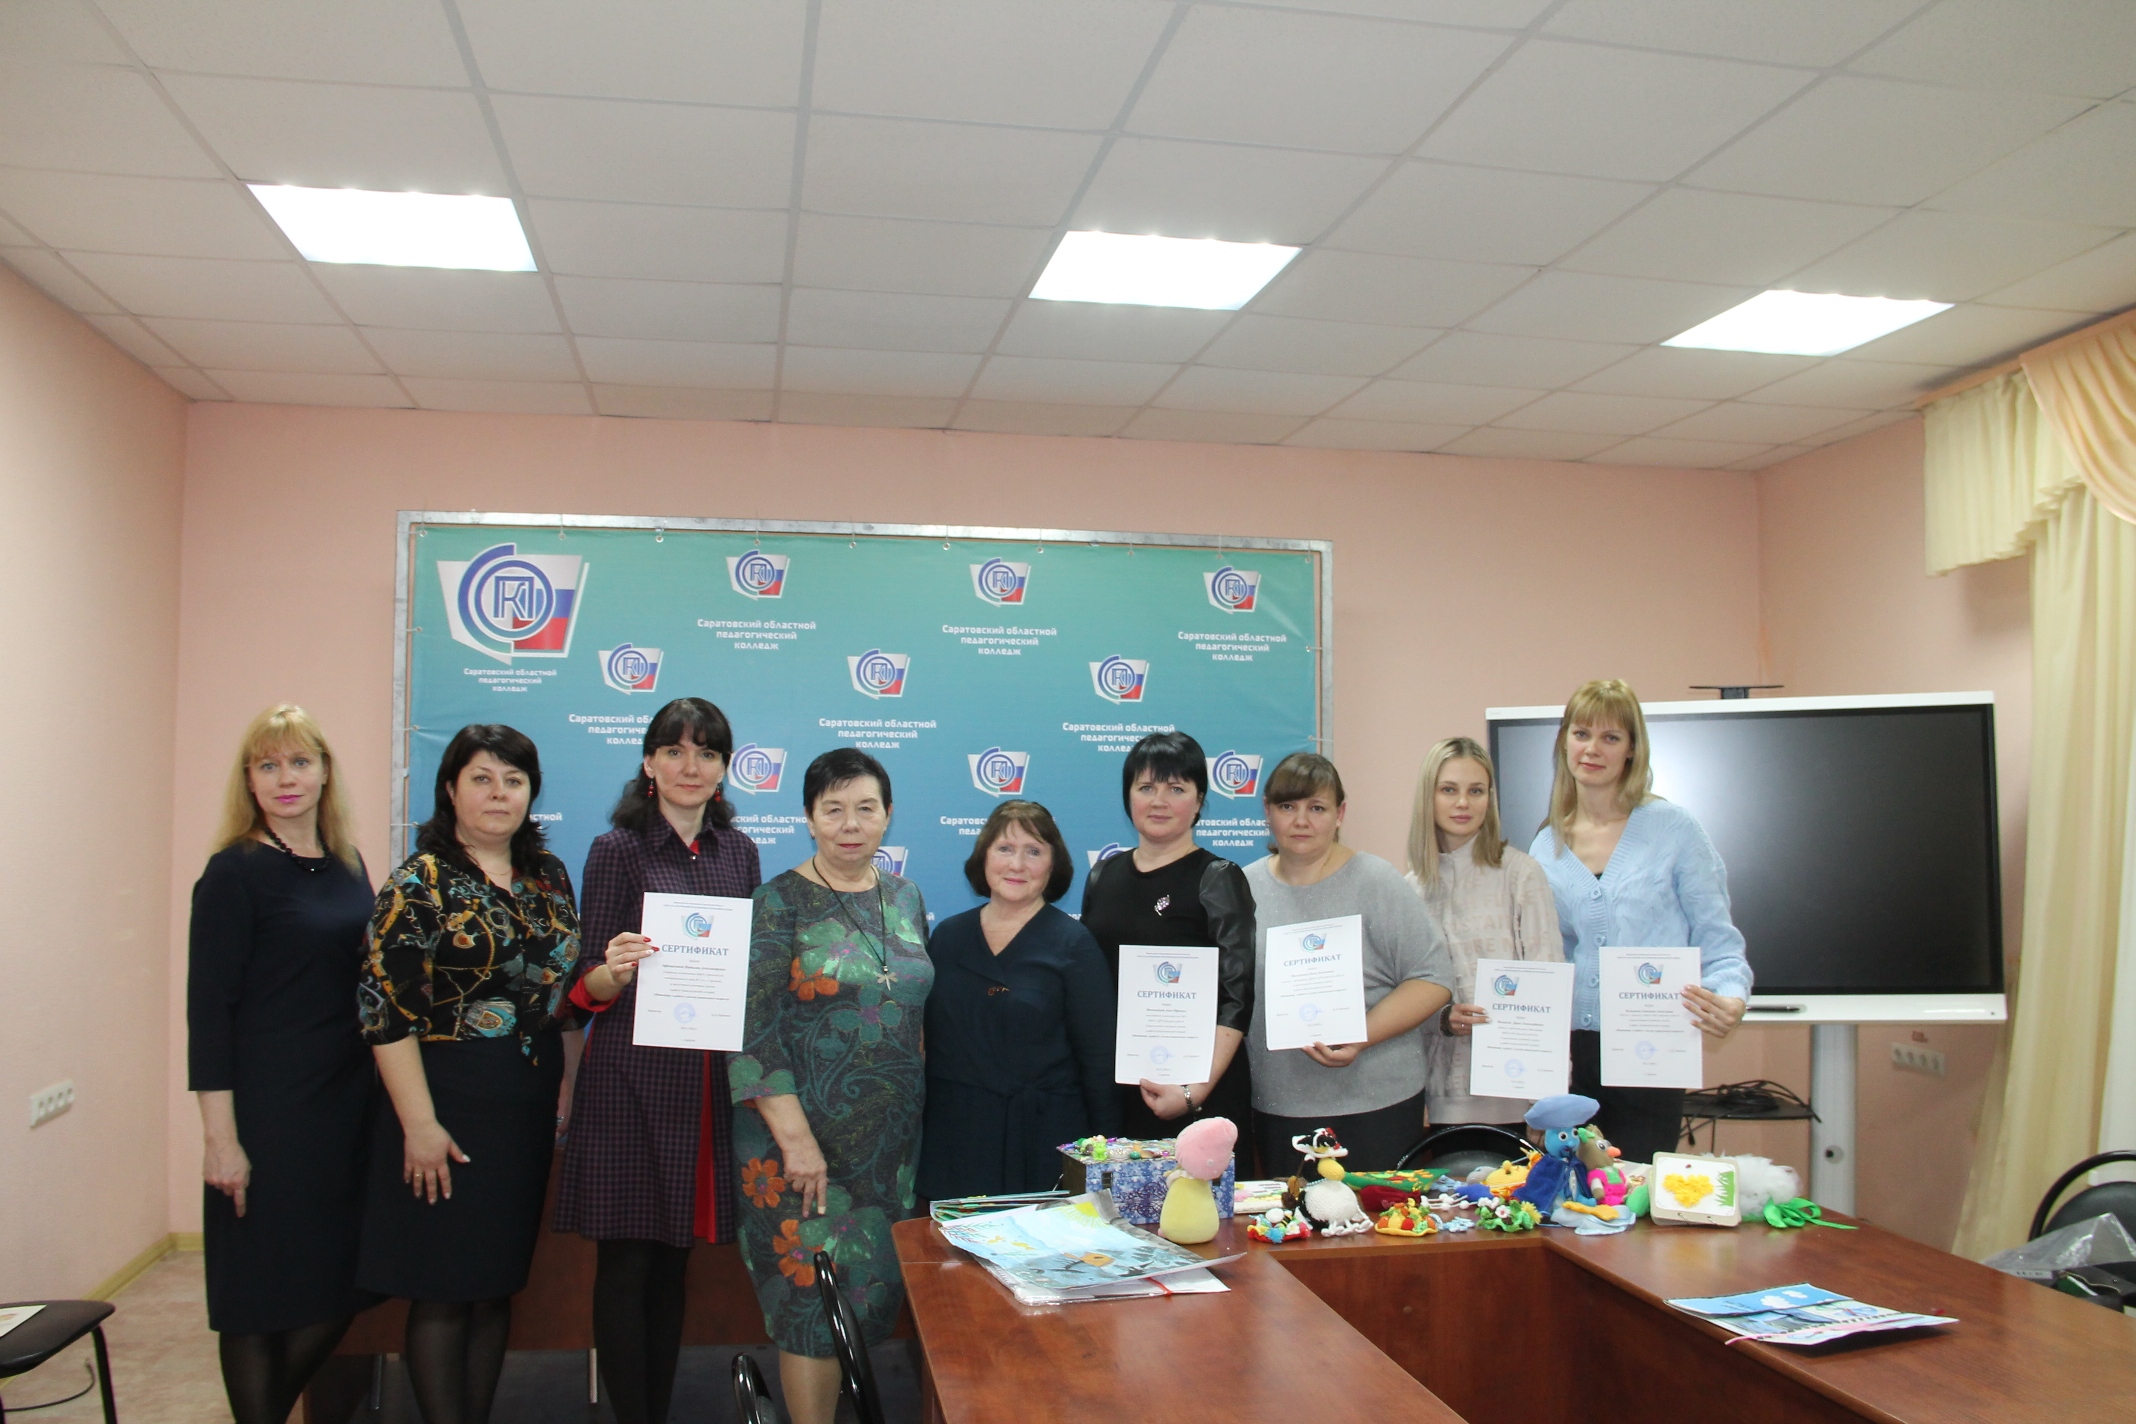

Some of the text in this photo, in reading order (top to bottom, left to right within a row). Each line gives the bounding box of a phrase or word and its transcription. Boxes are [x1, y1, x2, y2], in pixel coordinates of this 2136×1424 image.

[697, 619, 816, 630] Саратовский областной
[942, 624, 1057, 636] Саратовский областной
[716, 631, 797, 640] педагогический
[1178, 631, 1287, 642] Саратовский областной
[960, 636, 1039, 646] педагогический
[734, 642, 779, 650] колледж
[1195, 643, 1270, 652] педагогический
[978, 647, 1021, 655] колледж
[1212, 653, 1253, 661] колледж
[568, 713, 634, 724] Саратовский
[818, 718, 937, 728] Саратовский областной
[588, 726, 647, 734] педагогиче
[1062, 722, 1175, 733] Саратовский областной
[838, 730, 918, 739] педагогический
[1080, 734, 1143, 742] педагогичес
[606, 737, 643, 745] коллед
[855, 741, 900, 749] колледж
[761, 814, 807, 823] областно
[1196, 829, 1270, 837] педагогический
[1212, 839, 1254, 847] колледж
[662, 944, 729, 956] СЕРТИФИКАТ
[1284, 954, 1342, 967] СЕРТИФИКАТ
[1137, 990, 1197, 999] СЕРТИФИКАТ
[1619, 992, 1679, 1000] СЕРТИФИКАТ
[1492, 1003, 1551, 1014] СЕРТИФИКАТ
